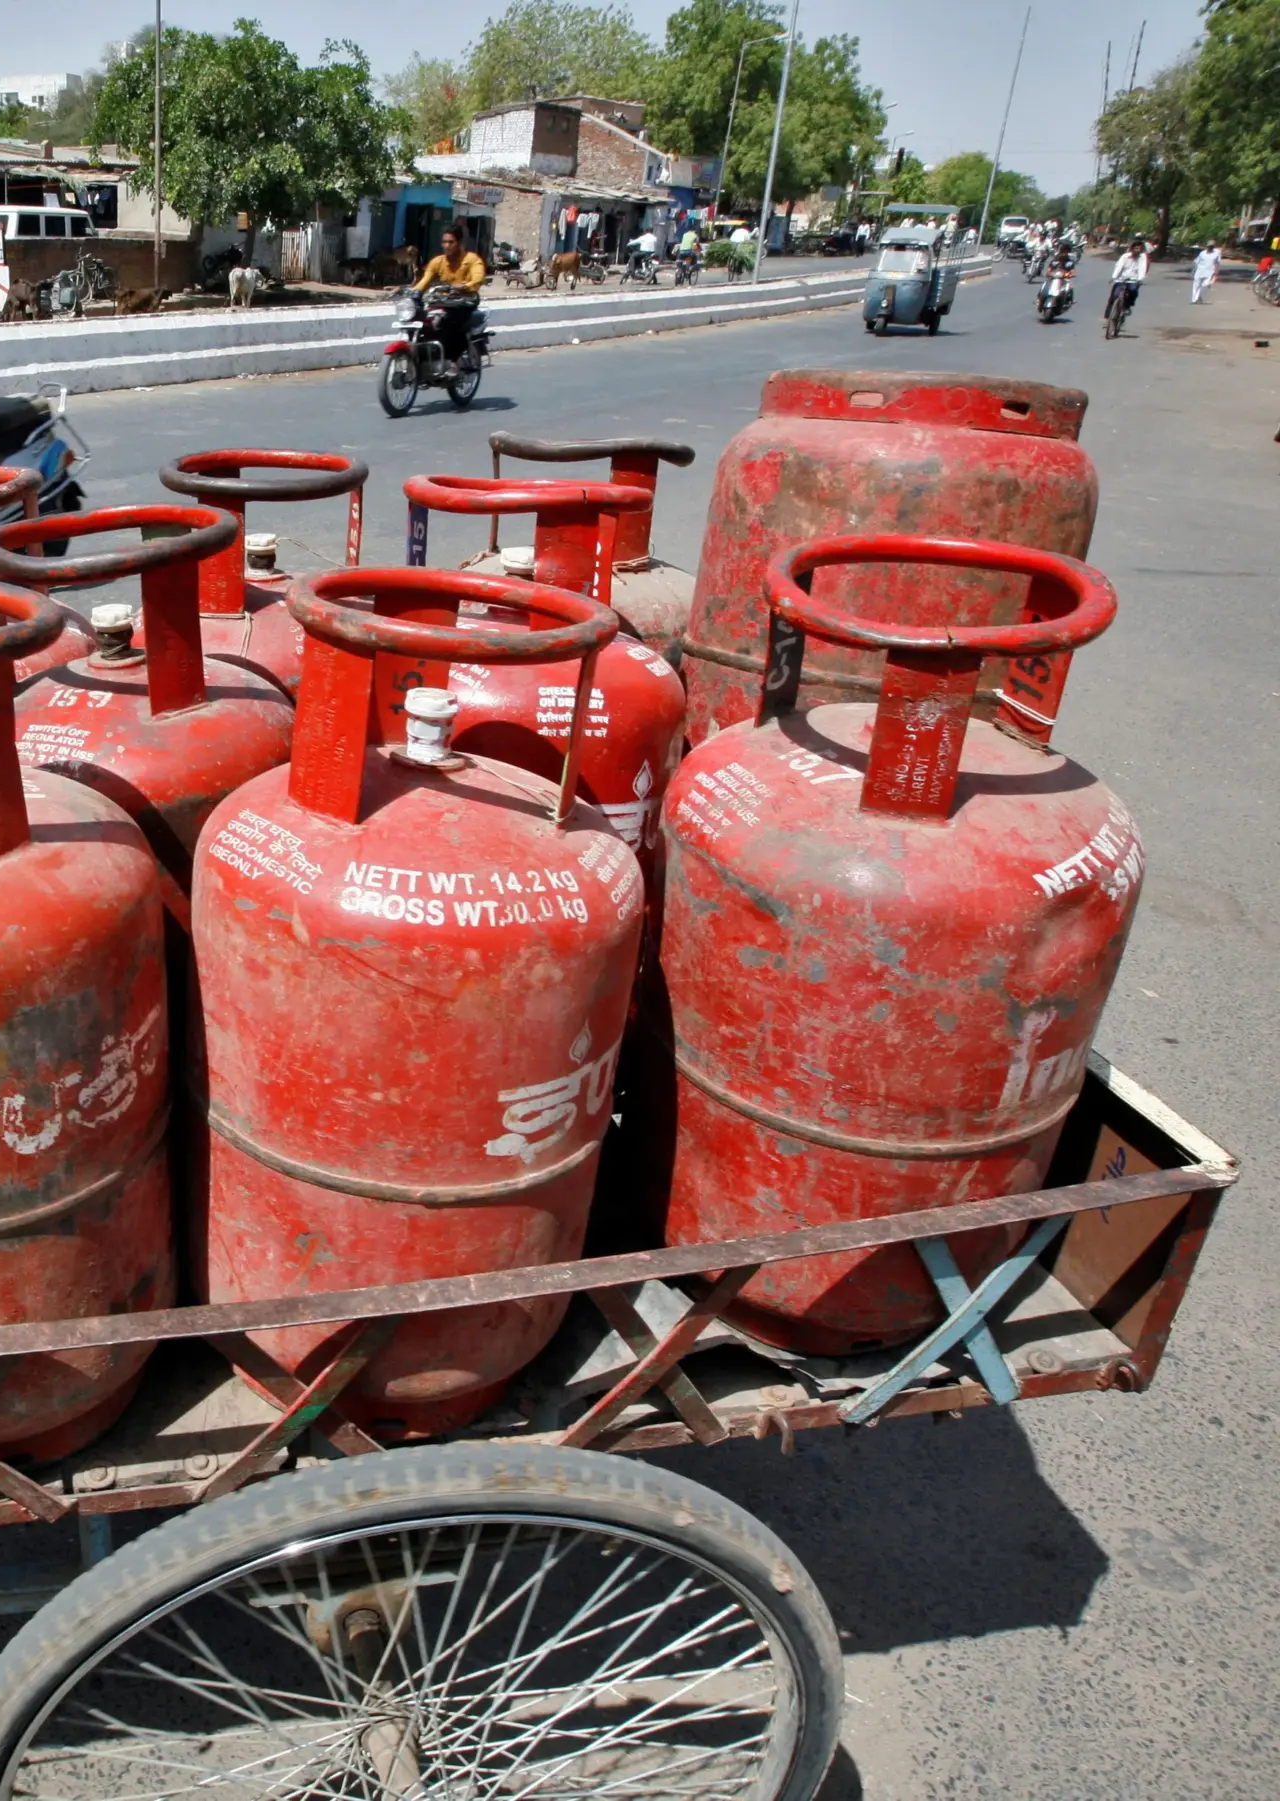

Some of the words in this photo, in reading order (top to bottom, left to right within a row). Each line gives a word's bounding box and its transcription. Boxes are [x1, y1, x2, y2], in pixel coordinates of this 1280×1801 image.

[539, 697, 556, 708] ON
[227, 820, 269, 845] उपयोग
[344, 861, 423, 893] NETT
[427, 871, 485, 896] WT.
[489, 869, 547, 895] 14.2
[544, 867, 580, 893] kg
[1031, 845, 1105, 900] NETT
[339, 886, 446, 927] GROSS
[452, 900, 505, 928] WT.
[556, 895, 589, 923] kg
